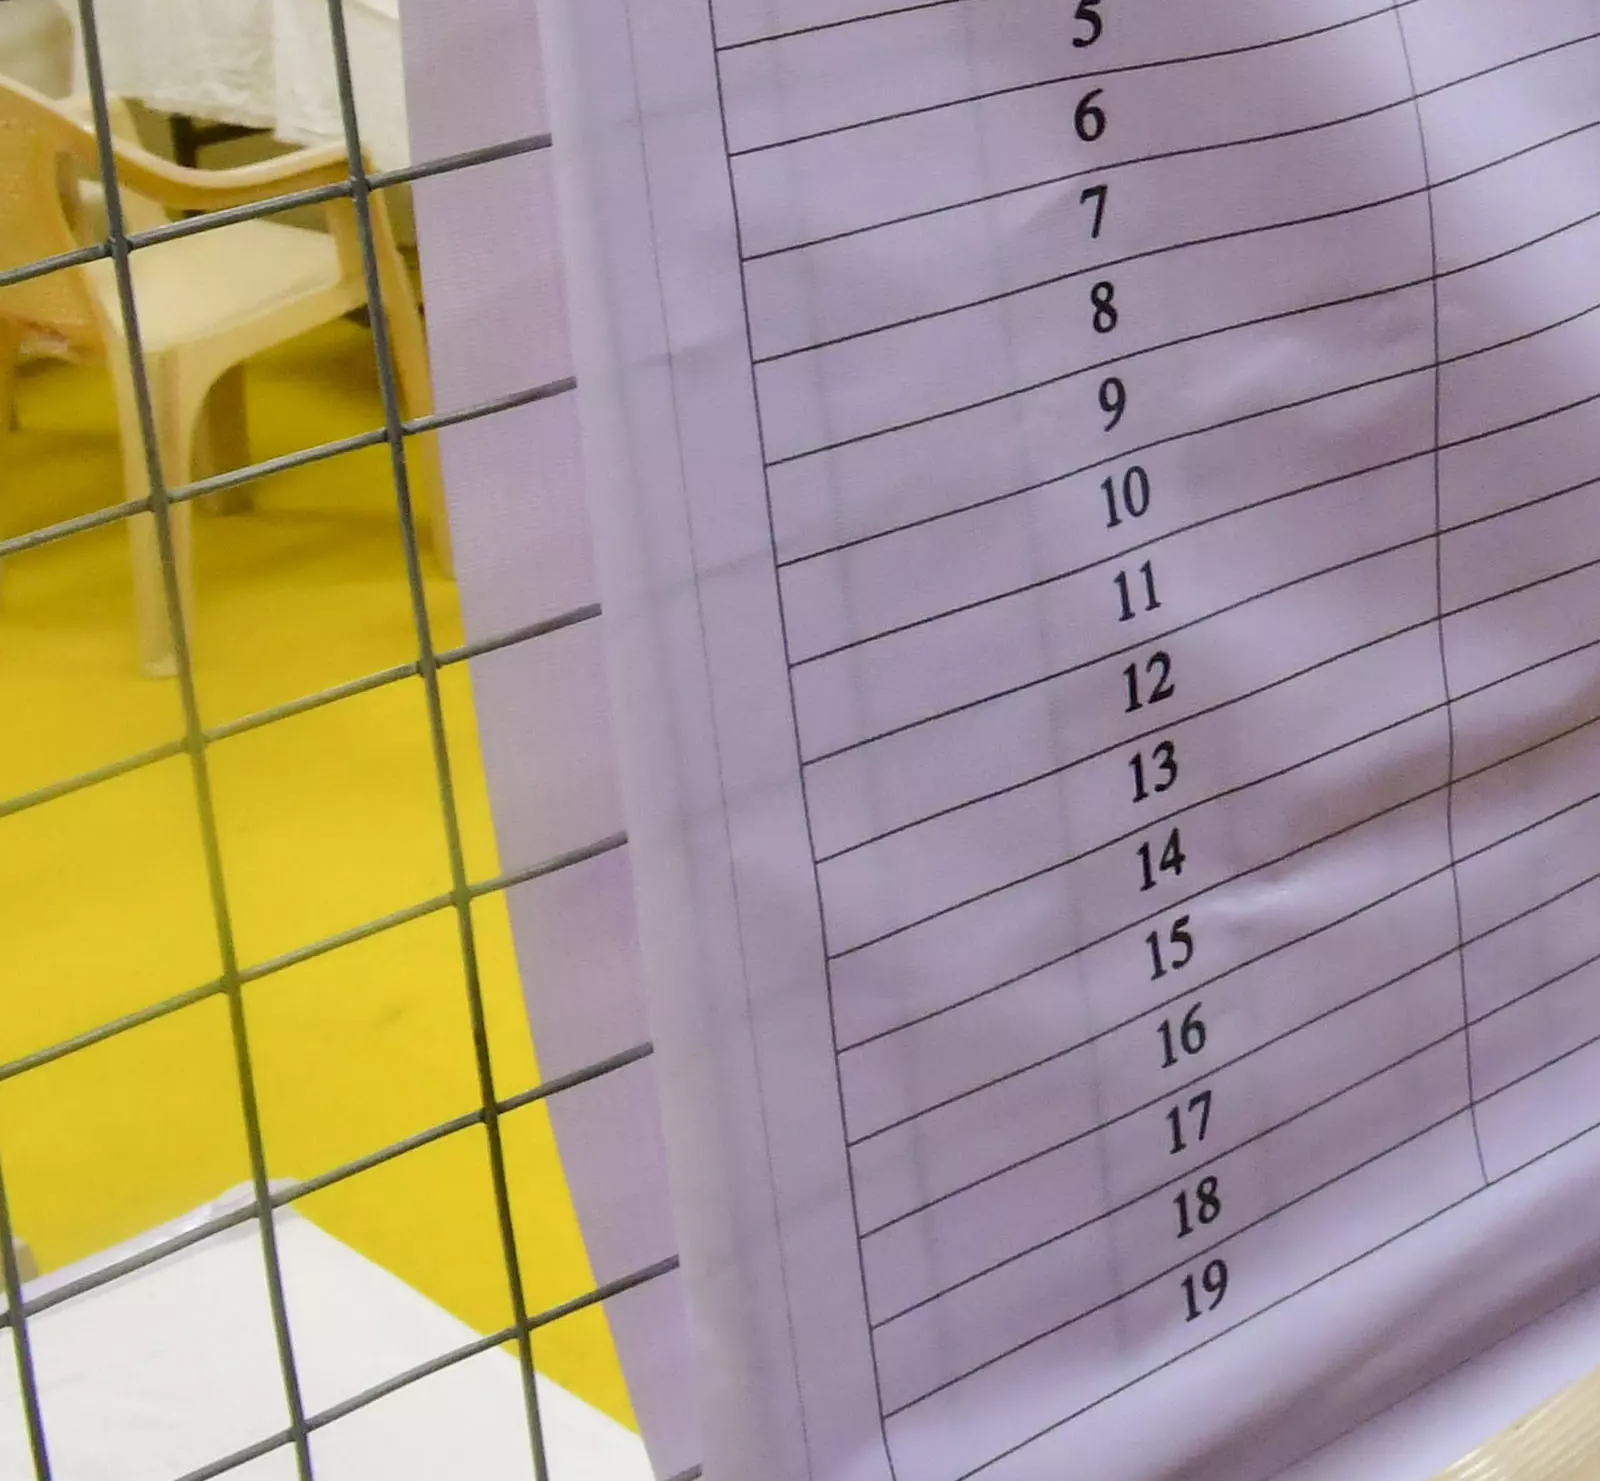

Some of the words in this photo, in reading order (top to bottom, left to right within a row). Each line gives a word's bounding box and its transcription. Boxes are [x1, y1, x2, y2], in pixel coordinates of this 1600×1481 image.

[1074, 88, 1106, 142] 6
[1080, 184, 1108, 238] 7
[1091, 281, 1118, 333] 8
[1099, 377, 1126, 432] 9
[1101, 466, 1150, 528] 10
[1114, 560, 1161, 621] 11
[1123, 650, 1175, 713] 12
[1129, 740, 1177, 803] 13
[1137, 828, 1186, 891] 14
[1146, 915, 1193, 980] 15
[1157, 1002, 1206, 1068] 16
[1167, 1090, 1211, 1154] 17
[1174, 1176, 1220, 1238] 18
[1181, 1259, 1227, 1322] 19
